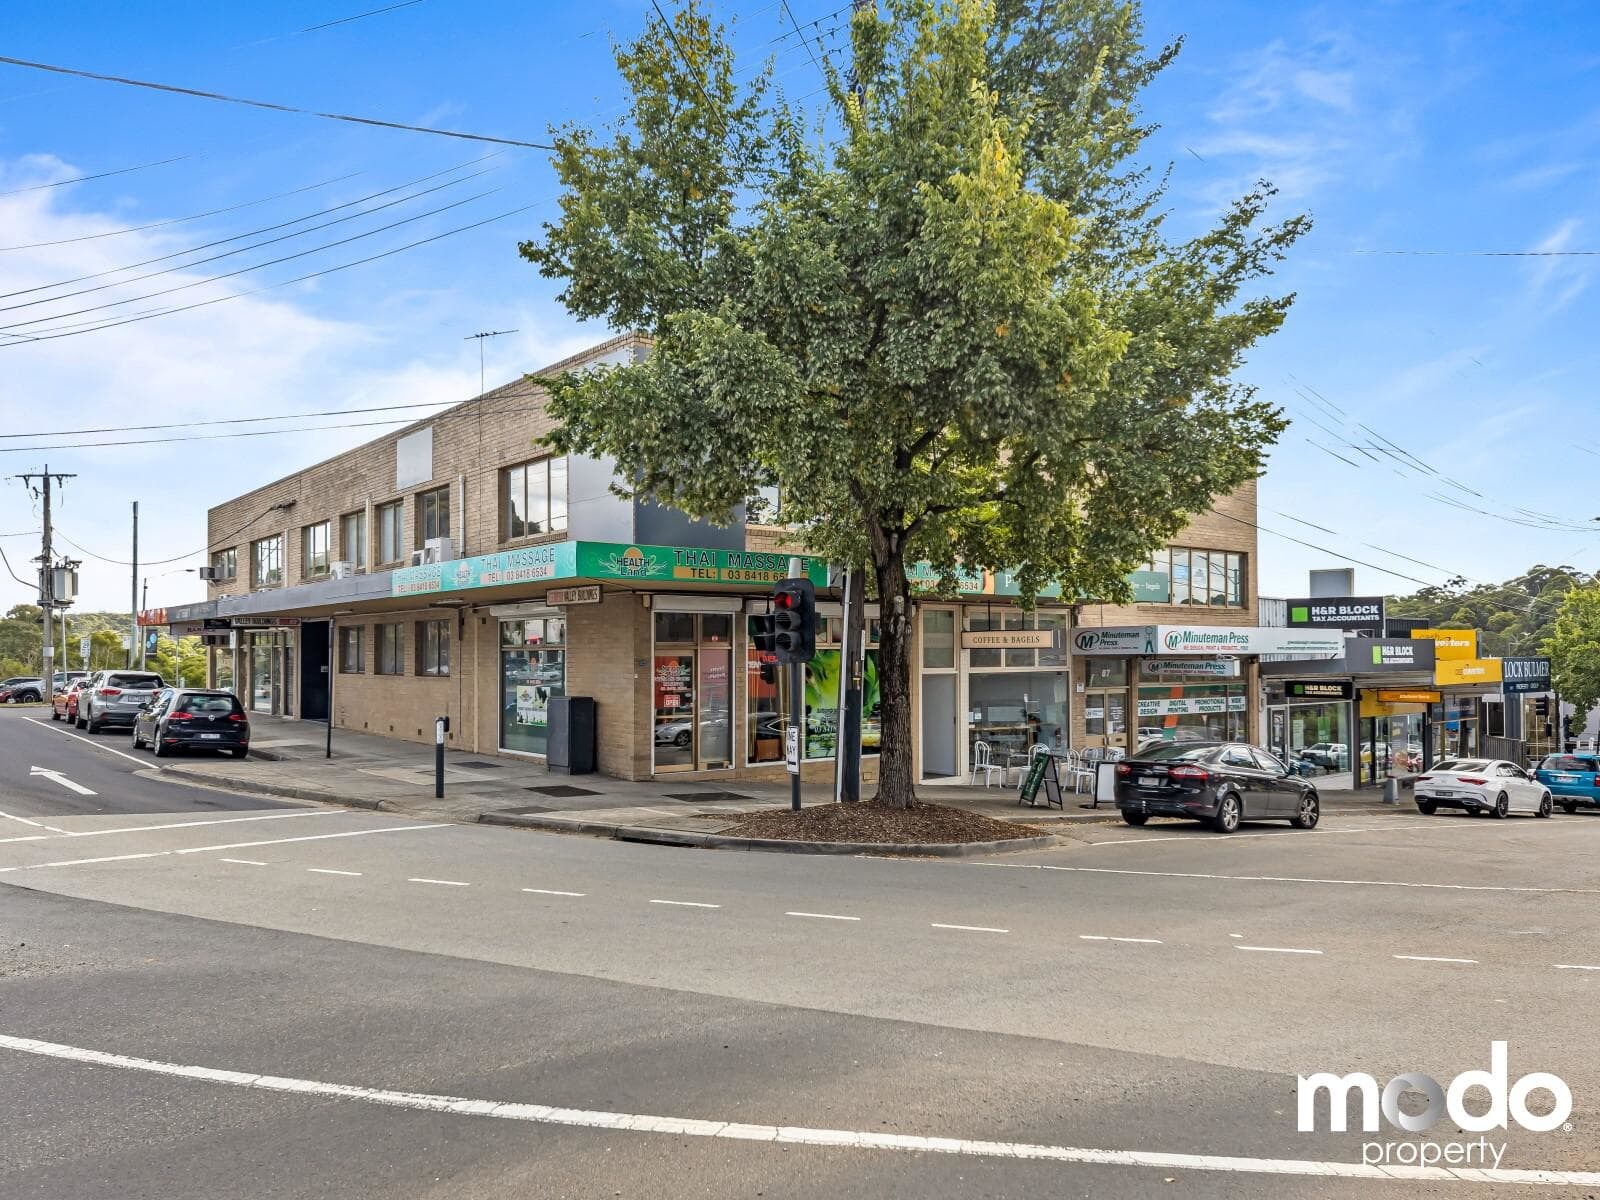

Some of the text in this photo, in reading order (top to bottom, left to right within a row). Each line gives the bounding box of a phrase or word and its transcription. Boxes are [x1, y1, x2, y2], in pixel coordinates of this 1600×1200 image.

[481, 548, 555, 571] THAI MASSAGE
[617, 557, 650, 567] HEALTH
[673, 550, 809, 571] THAI MASSAE
[506, 571, 514, 580] 03
[531, 566, 548, 578] 6534
[690, 568, 716, 579] TEL:
[727, 570, 741, 580] 03
[744, 570, 769, 581] 8418
[1311, 605, 1380, 615] H&R BLOCK
[1327, 614, 1380, 622] ACCOUNTANTS
[972, 635, 1040, 644] COFFEE & BAGELS
[1101, 631, 1140, 639] Minuteman
[1182, 630, 1249, 644] Minuteman Press
[1382, 645, 1414, 656] H&R BLOCK
[1163, 661, 1226, 670] Minuteman Press
[1504, 661, 1550, 678] LOCK BULMER
[1319, 684, 1342, 692] BLOCK
[1138, 700, 1161, 708] CREATIVE
